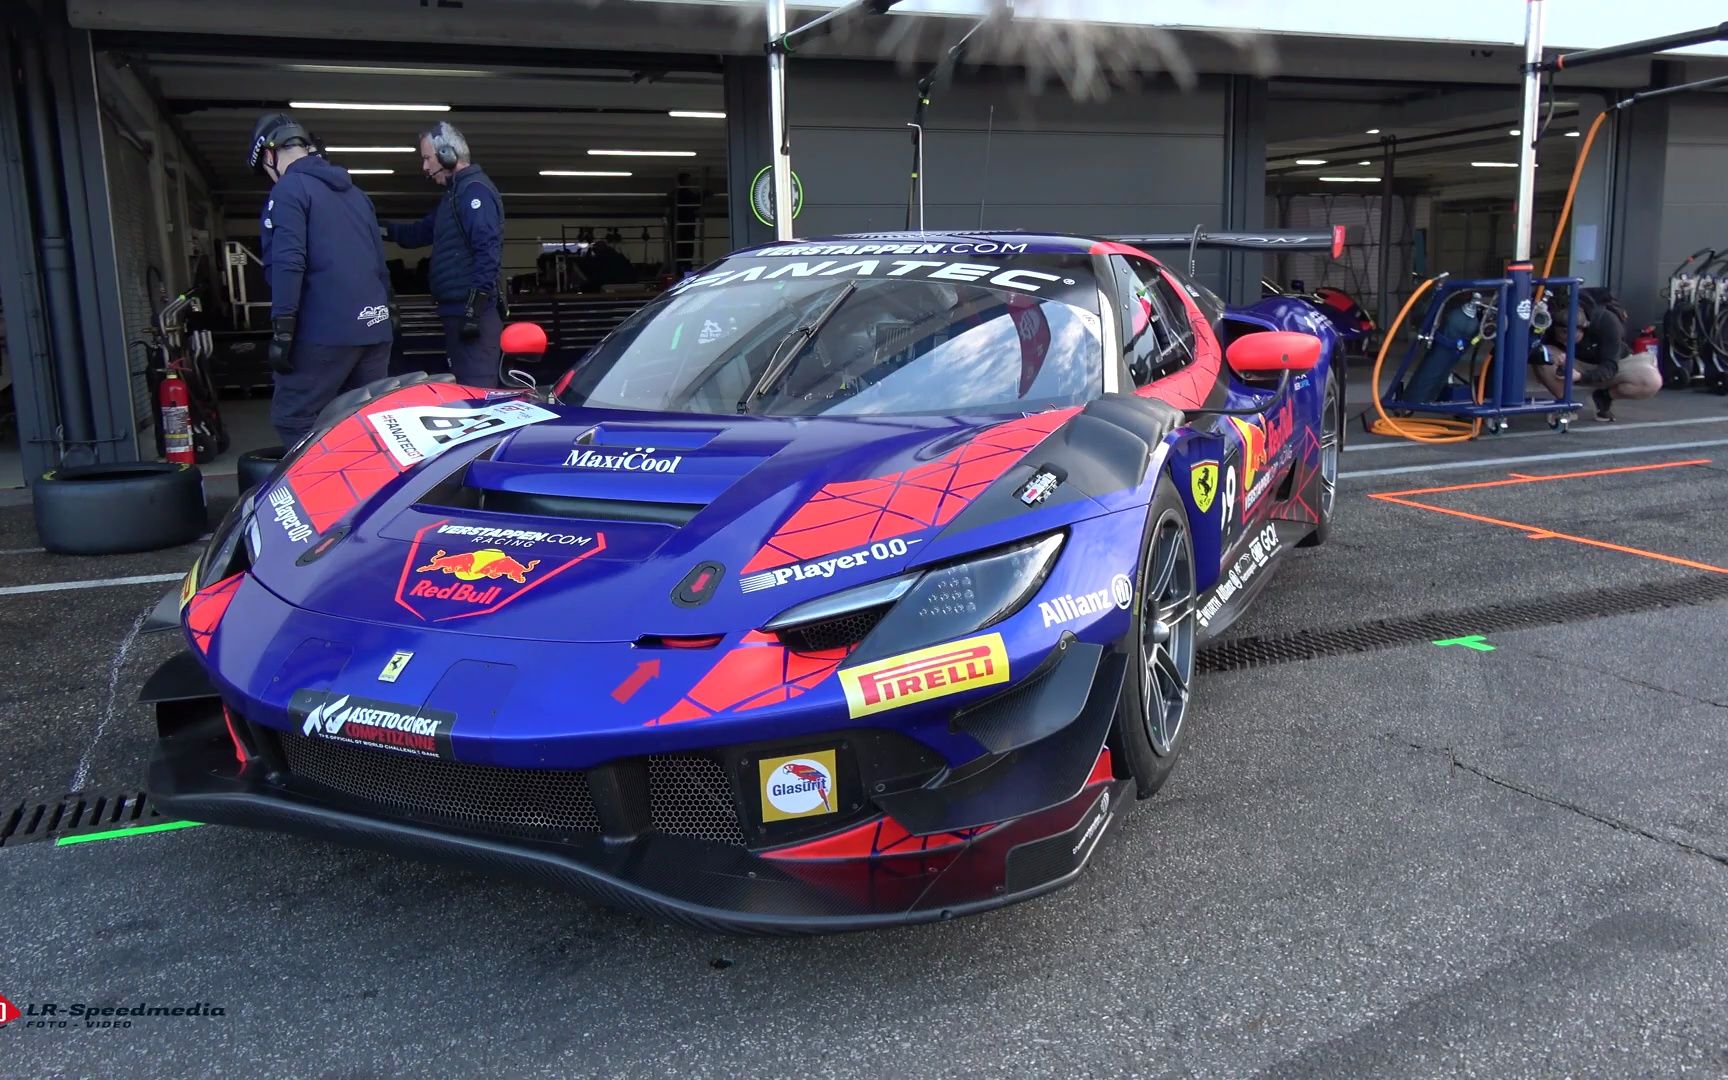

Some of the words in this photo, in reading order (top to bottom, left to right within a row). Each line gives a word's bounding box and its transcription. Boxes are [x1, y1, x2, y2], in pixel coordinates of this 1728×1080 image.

[756, 243, 1028, 257] VERSTAPPEN.COM
[669, 260, 1066, 296] FANATEC
[562, 447, 682, 473] MaxiCool
[436, 524, 593, 547] VERSTAPPEN.COM
[471, 536, 536, 548] RACING
[1260, 522, 1279, 552] GO!
[773, 549, 870, 586] Player
[409, 579, 457, 600] Red
[451, 581, 502, 605] Bull
[1038, 588, 1113, 628] Allianz
[857, 645, 995, 706] PIRELLI
[344, 722, 436, 752] COMPETIZIONE
[346, 707, 401, 728] ASSETTO
[398, 715, 438, 737] CORSA
[772, 778, 827, 796] Glasurit
